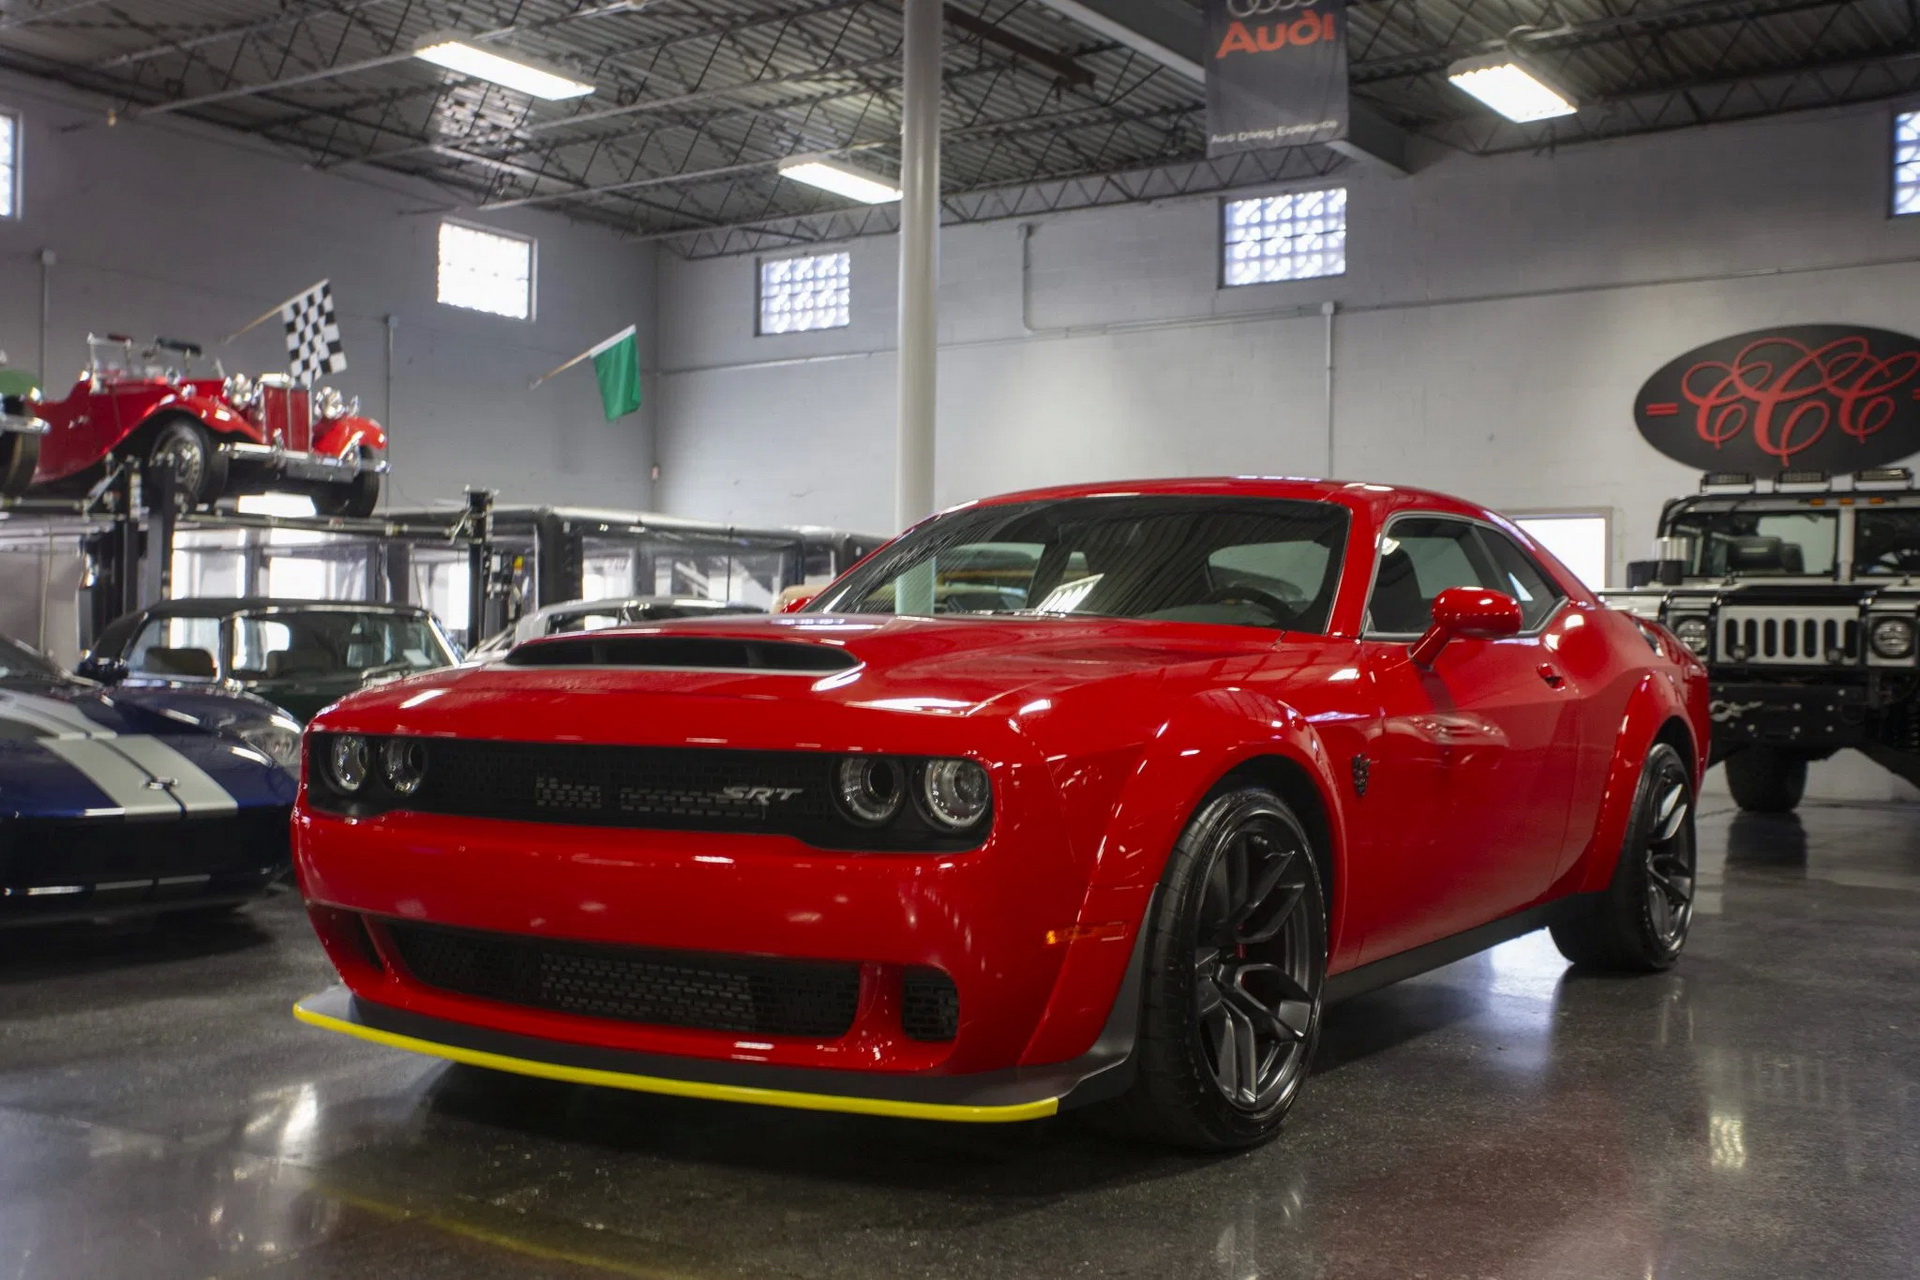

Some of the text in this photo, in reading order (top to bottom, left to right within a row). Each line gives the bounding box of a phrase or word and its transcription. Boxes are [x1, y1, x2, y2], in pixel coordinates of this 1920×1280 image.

[1215, 9, 1335, 59] Audi
[1211, 119, 1338, 144] Audi Driving Experience
[716, 786, 804, 806] SRT
